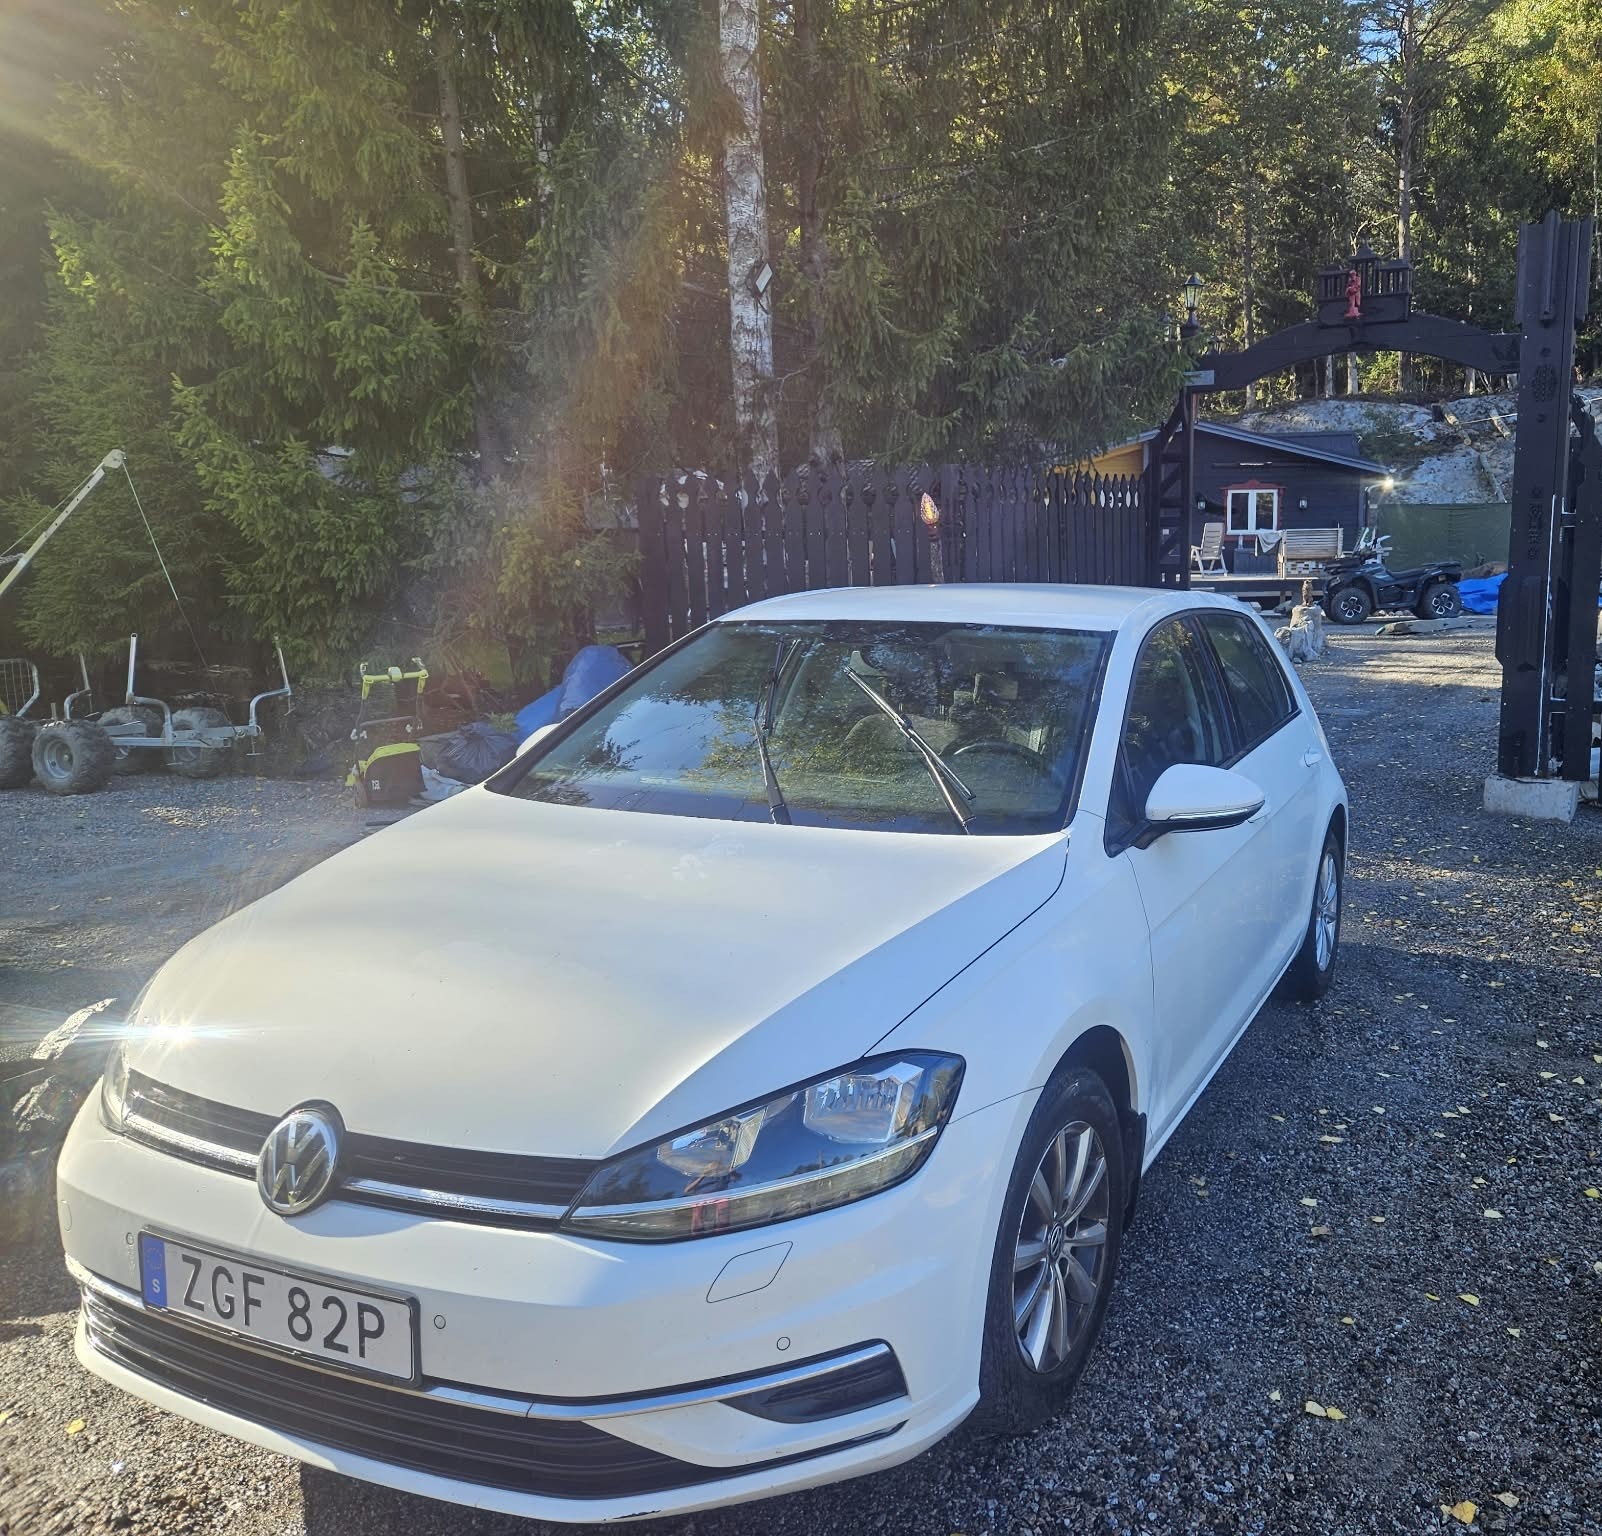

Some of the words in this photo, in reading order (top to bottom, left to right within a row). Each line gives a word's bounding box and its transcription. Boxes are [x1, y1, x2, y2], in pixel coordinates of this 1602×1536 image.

[151, 1278, 161, 1294] S
[181, 1253, 265, 1327] ZGF
[287, 1286, 385, 1359] 82P
